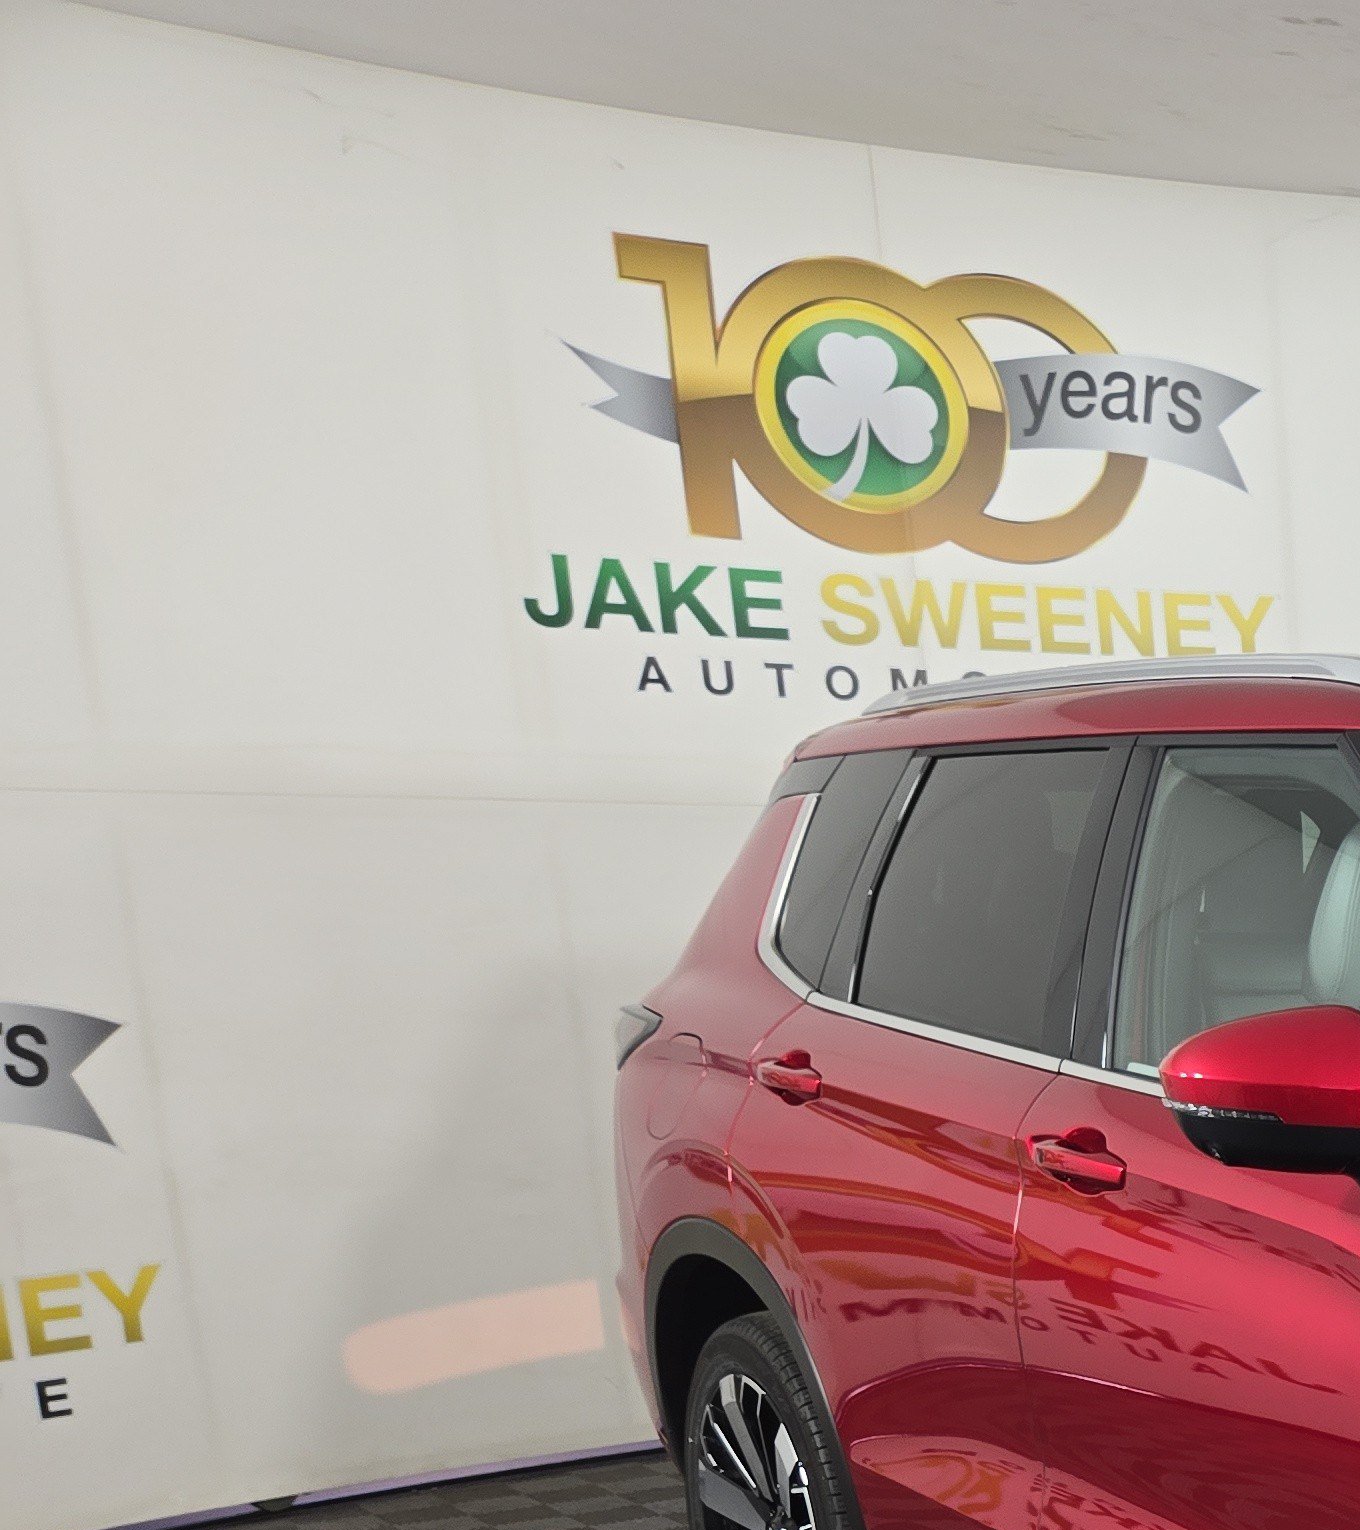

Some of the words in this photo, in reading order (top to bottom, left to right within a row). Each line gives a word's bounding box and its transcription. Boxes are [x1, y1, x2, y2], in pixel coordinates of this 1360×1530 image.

[1020, 369, 1203, 436] years
[523, 554, 790, 641] JAKE
[819, 573, 1276, 657] SWEENEY
[638, 655, 988, 701] AUTOM
